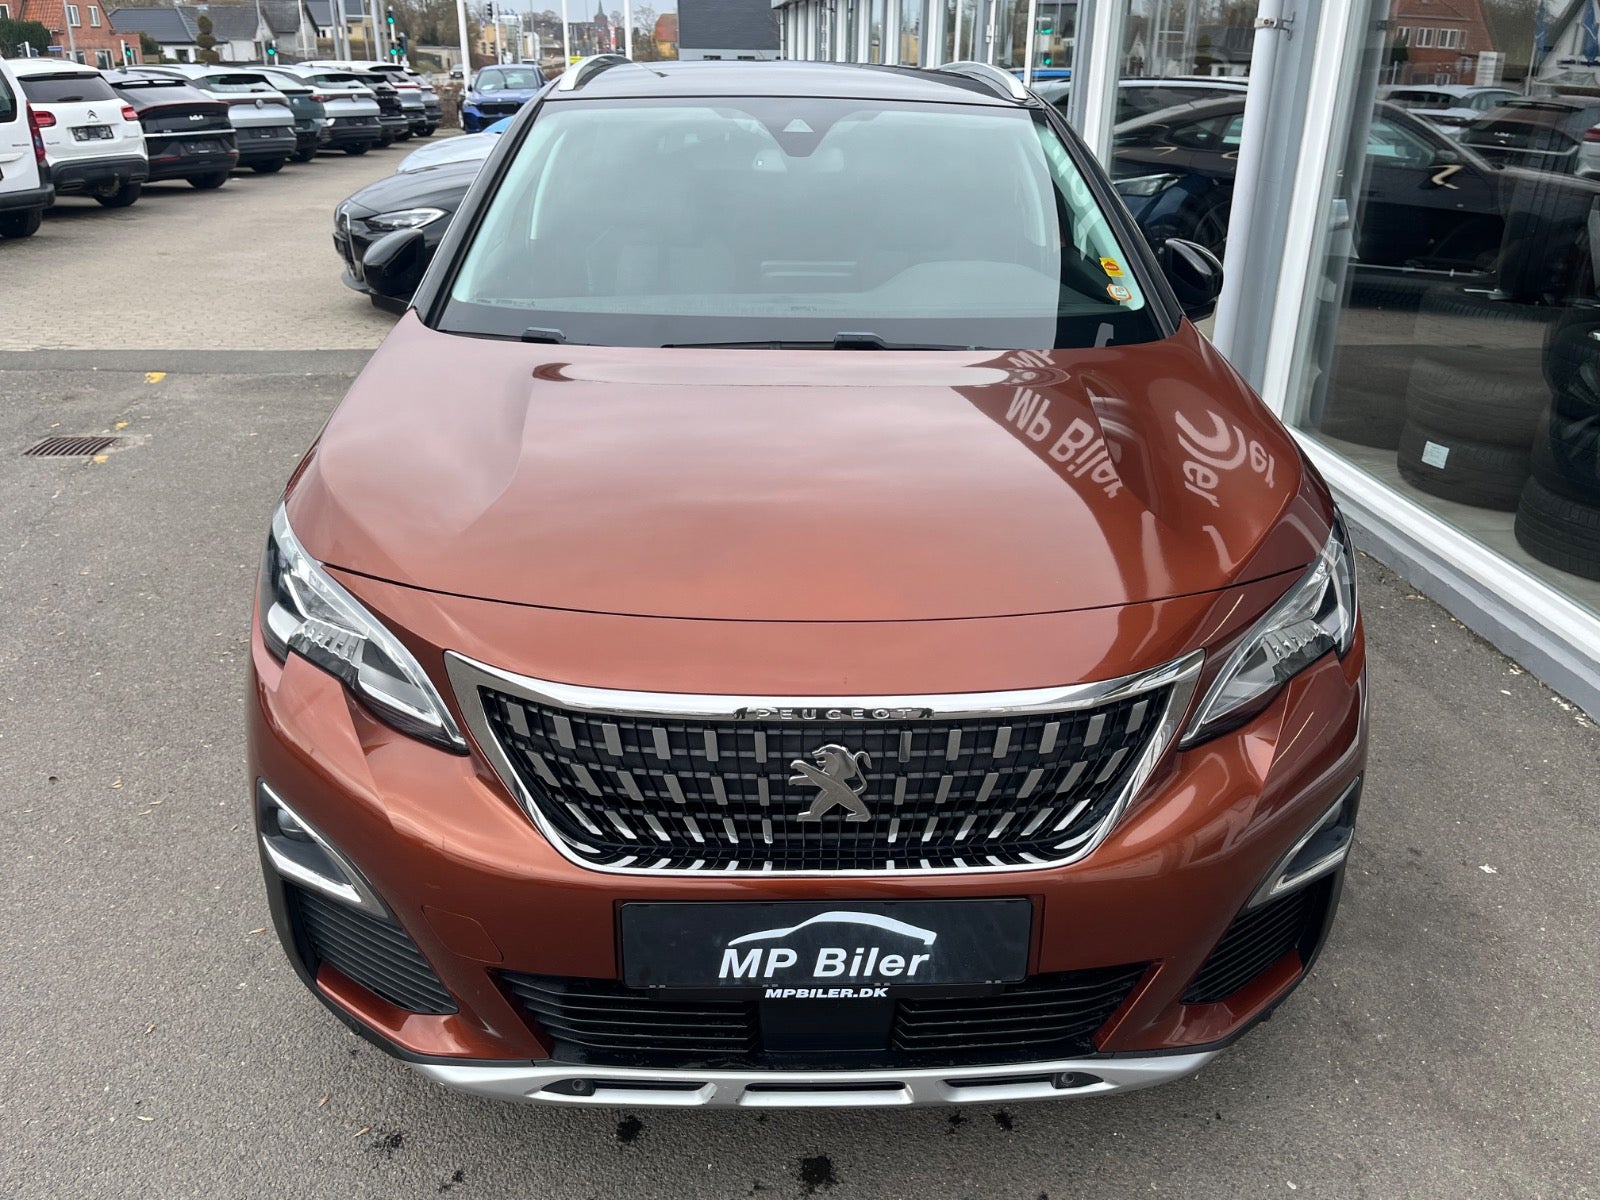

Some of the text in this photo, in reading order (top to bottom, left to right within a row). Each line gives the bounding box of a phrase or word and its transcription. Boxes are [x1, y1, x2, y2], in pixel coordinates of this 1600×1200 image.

[755, 708, 913, 720] PEUGEOT
[718, 947, 930, 979] MP Biler
[764, 987, 889, 999] MPBILER.DK
